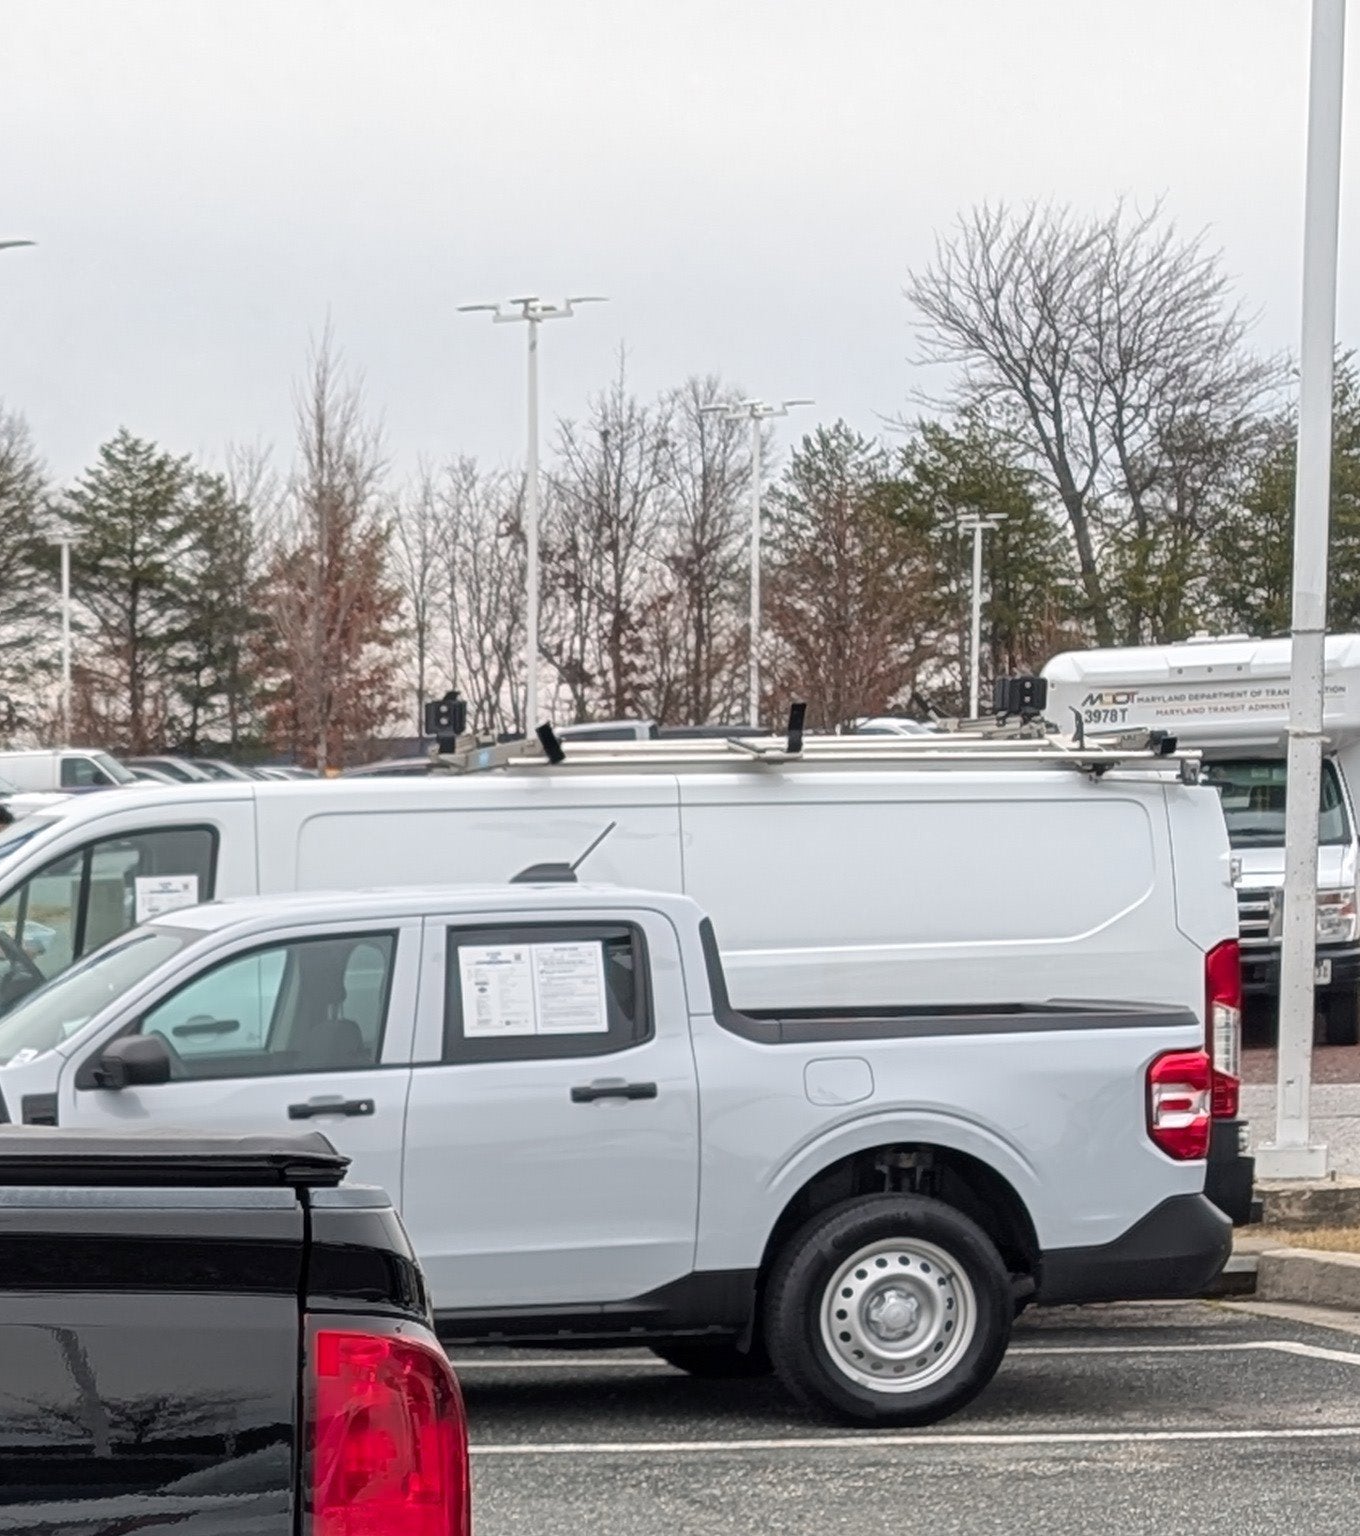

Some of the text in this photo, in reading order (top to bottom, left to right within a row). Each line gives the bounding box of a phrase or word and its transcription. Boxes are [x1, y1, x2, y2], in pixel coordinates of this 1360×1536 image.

[1137, 693, 1186, 703] MARYLAND
[1187, 690, 1248, 701] DEPARTMENT
[1250, 689, 1262, 698] OF
[1155, 706, 1206, 716] MARYLAND
[1208, 704, 1245, 714] TRANSIT
